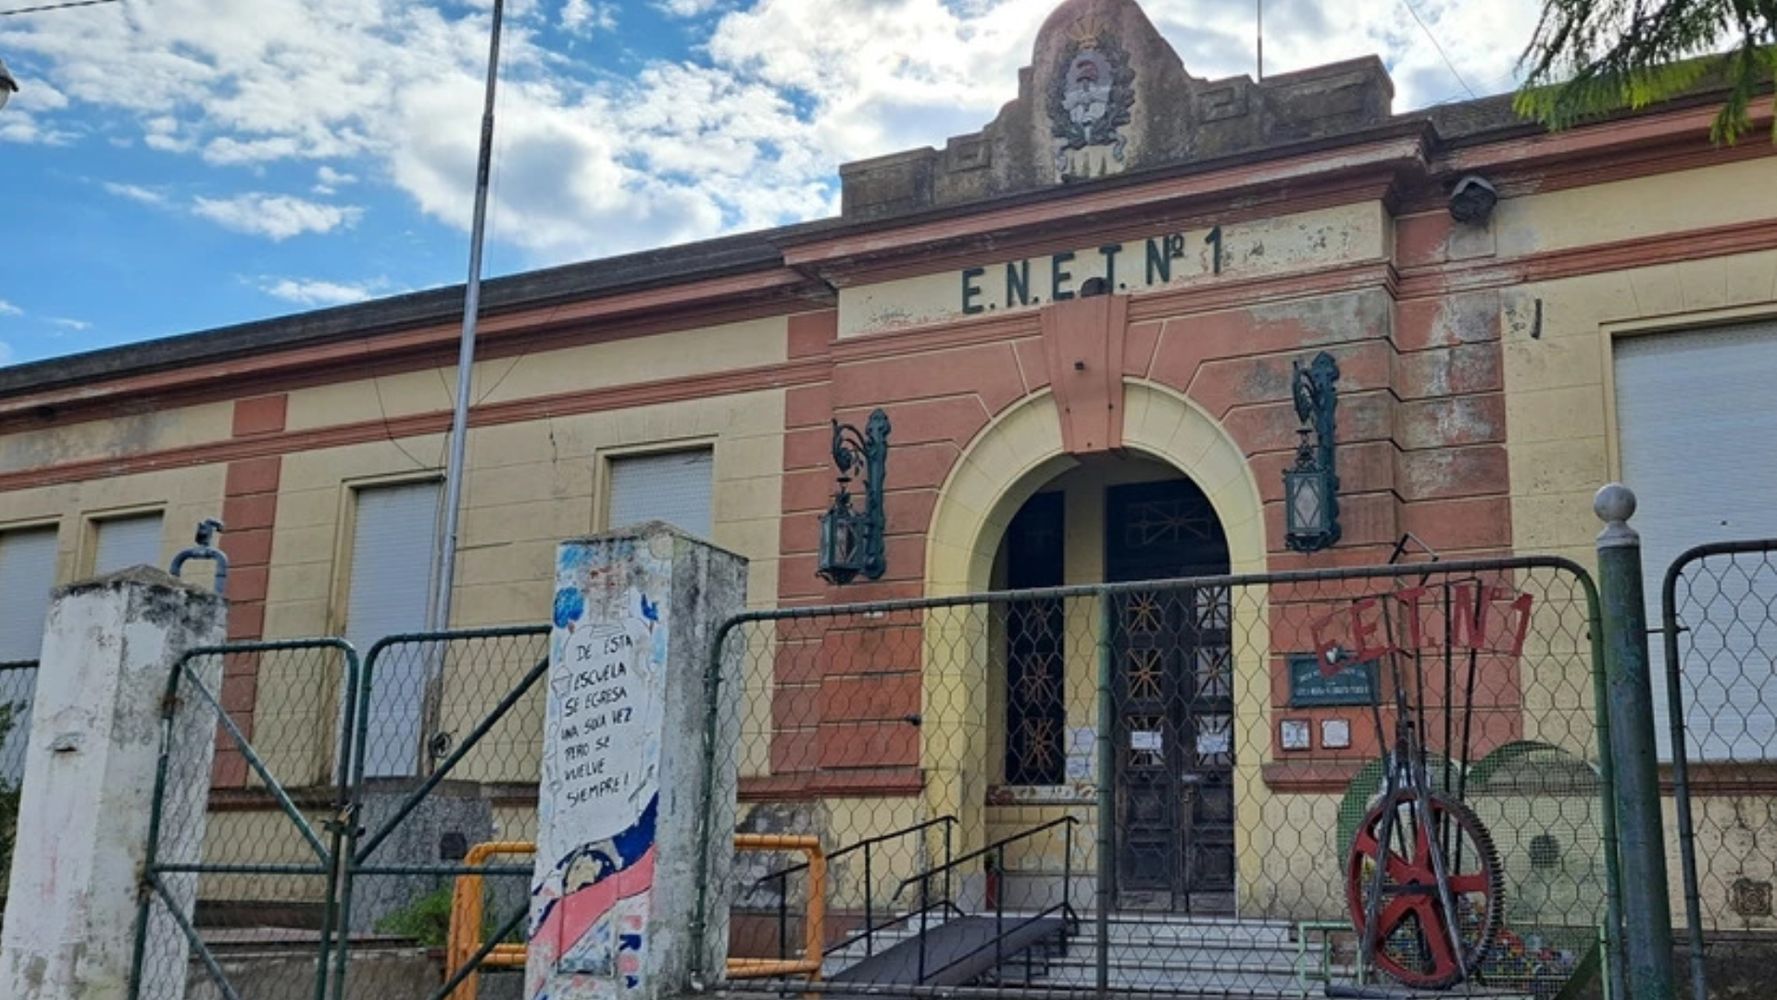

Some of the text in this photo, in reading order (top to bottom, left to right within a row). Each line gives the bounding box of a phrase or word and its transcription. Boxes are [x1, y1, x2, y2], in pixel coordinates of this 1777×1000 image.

[962, 243, 1126, 314] E.N.ET.
[1205, 224, 1223, 275] 1
[576, 634, 634, 661] DE ESTA
[574, 662, 627, 691] ESCUELA
[565, 686, 628, 717] SE EGRESA
[612, 706, 633, 724] VEZ
[565, 736, 610, 762] PERO SE
[564, 757, 605, 781] VUELVE
